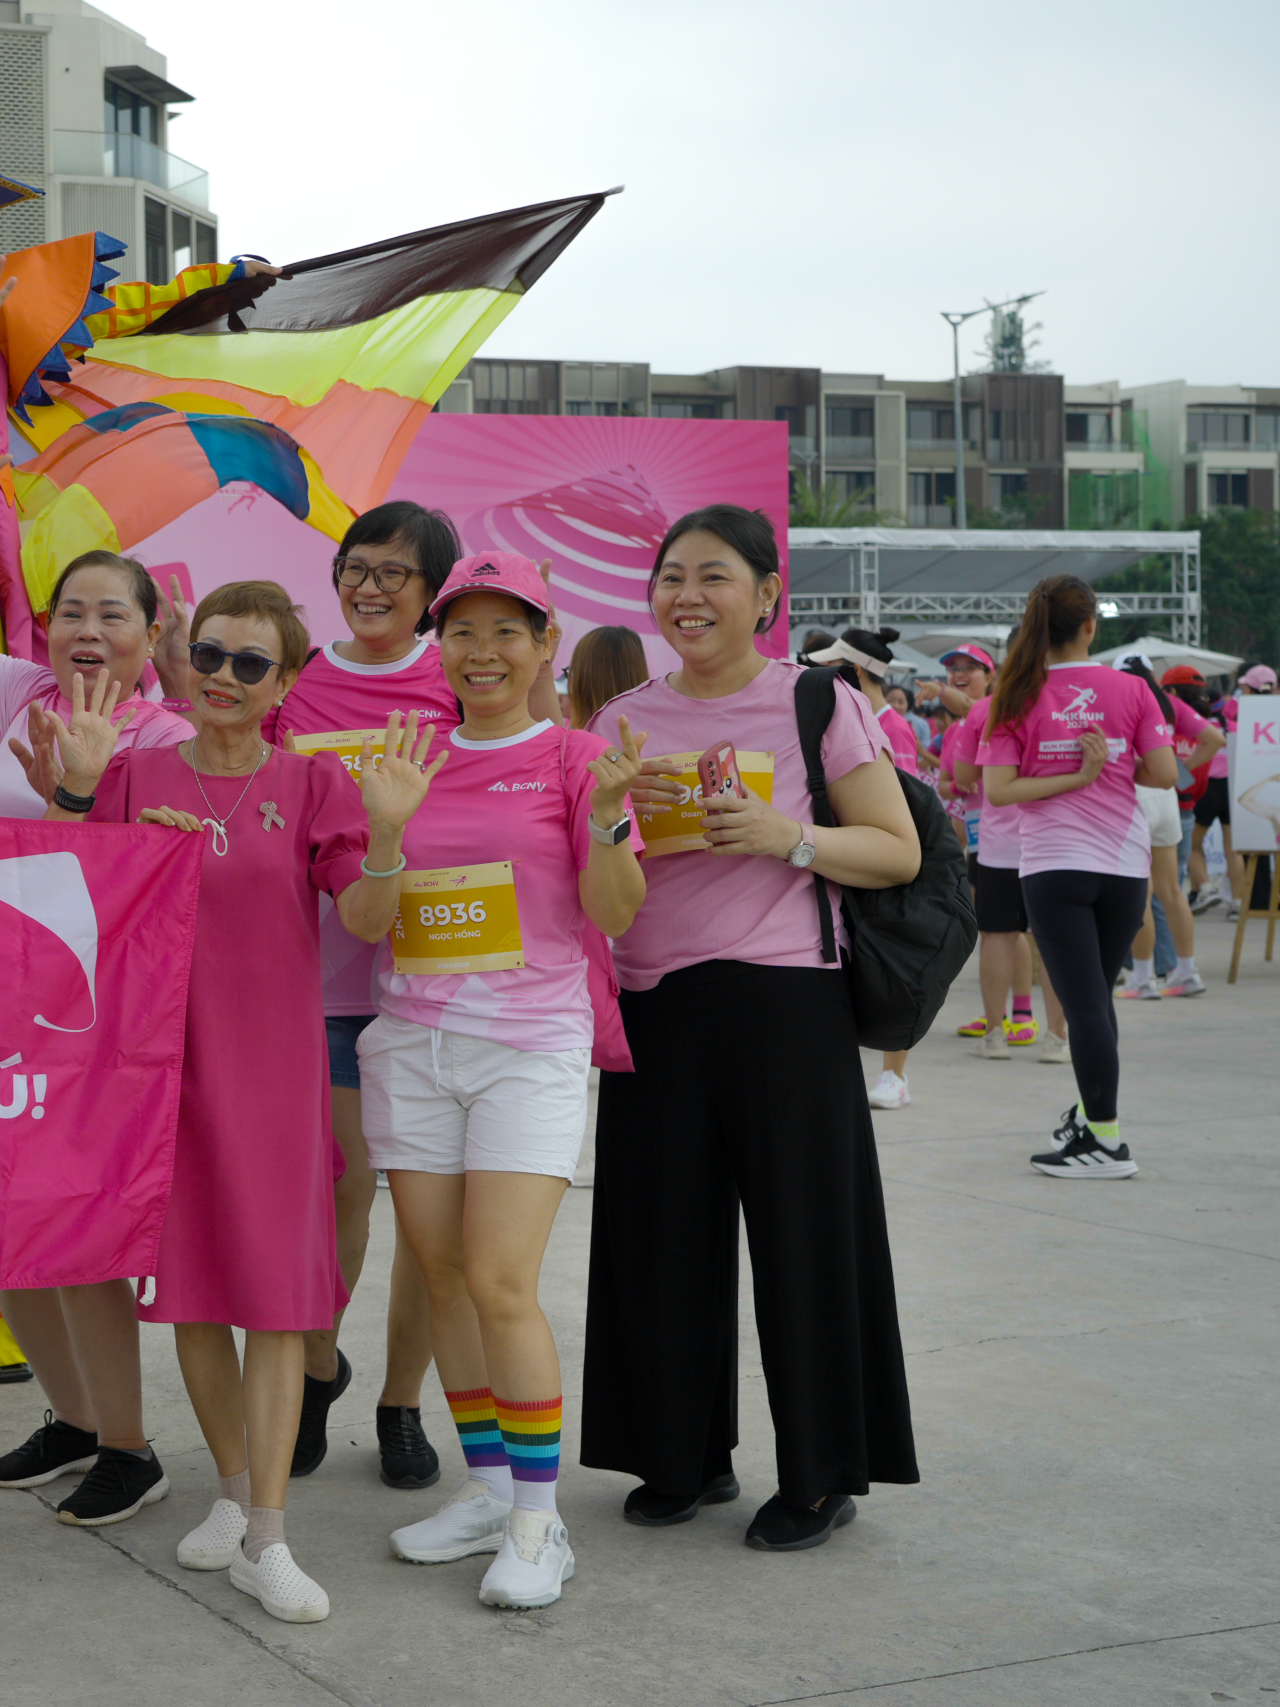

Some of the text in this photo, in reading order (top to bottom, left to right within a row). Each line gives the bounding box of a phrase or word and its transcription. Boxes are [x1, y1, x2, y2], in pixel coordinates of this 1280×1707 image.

[416, 710, 442, 718] CNV
[1051, 712, 1104, 721] PINKRUN
[1066, 721, 1089, 729] 2025
[512, 781, 546, 792] BCNV
[681, 811, 702, 819] Đoan
[419, 901, 487, 926] 8936
[429, 933, 452, 941] NGỌC
